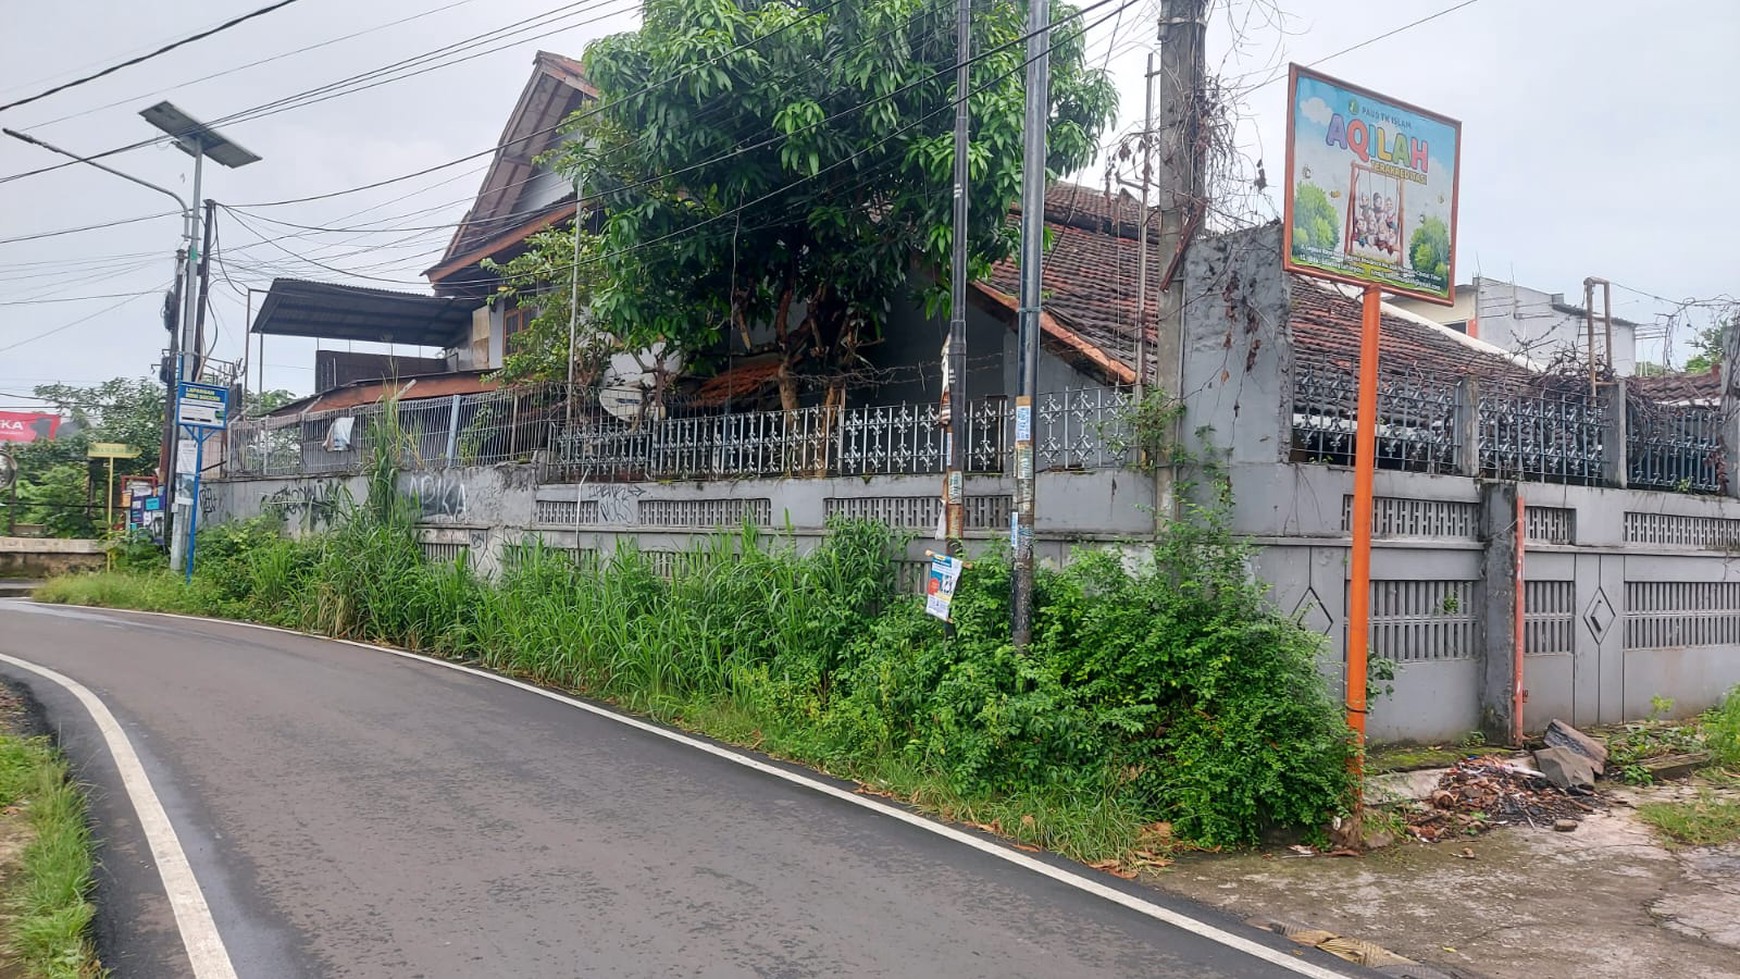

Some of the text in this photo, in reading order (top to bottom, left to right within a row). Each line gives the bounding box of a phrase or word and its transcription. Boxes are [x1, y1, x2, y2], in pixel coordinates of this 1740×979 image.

[1380, 112, 1391, 122] TK
[1391, 115, 1412, 129] ISLAM
[1326, 113, 1428, 173] AQILAH
[1371, 160, 1427, 185] TERAKREDITASI
[186, 387, 215, 396] LAPANGAN
